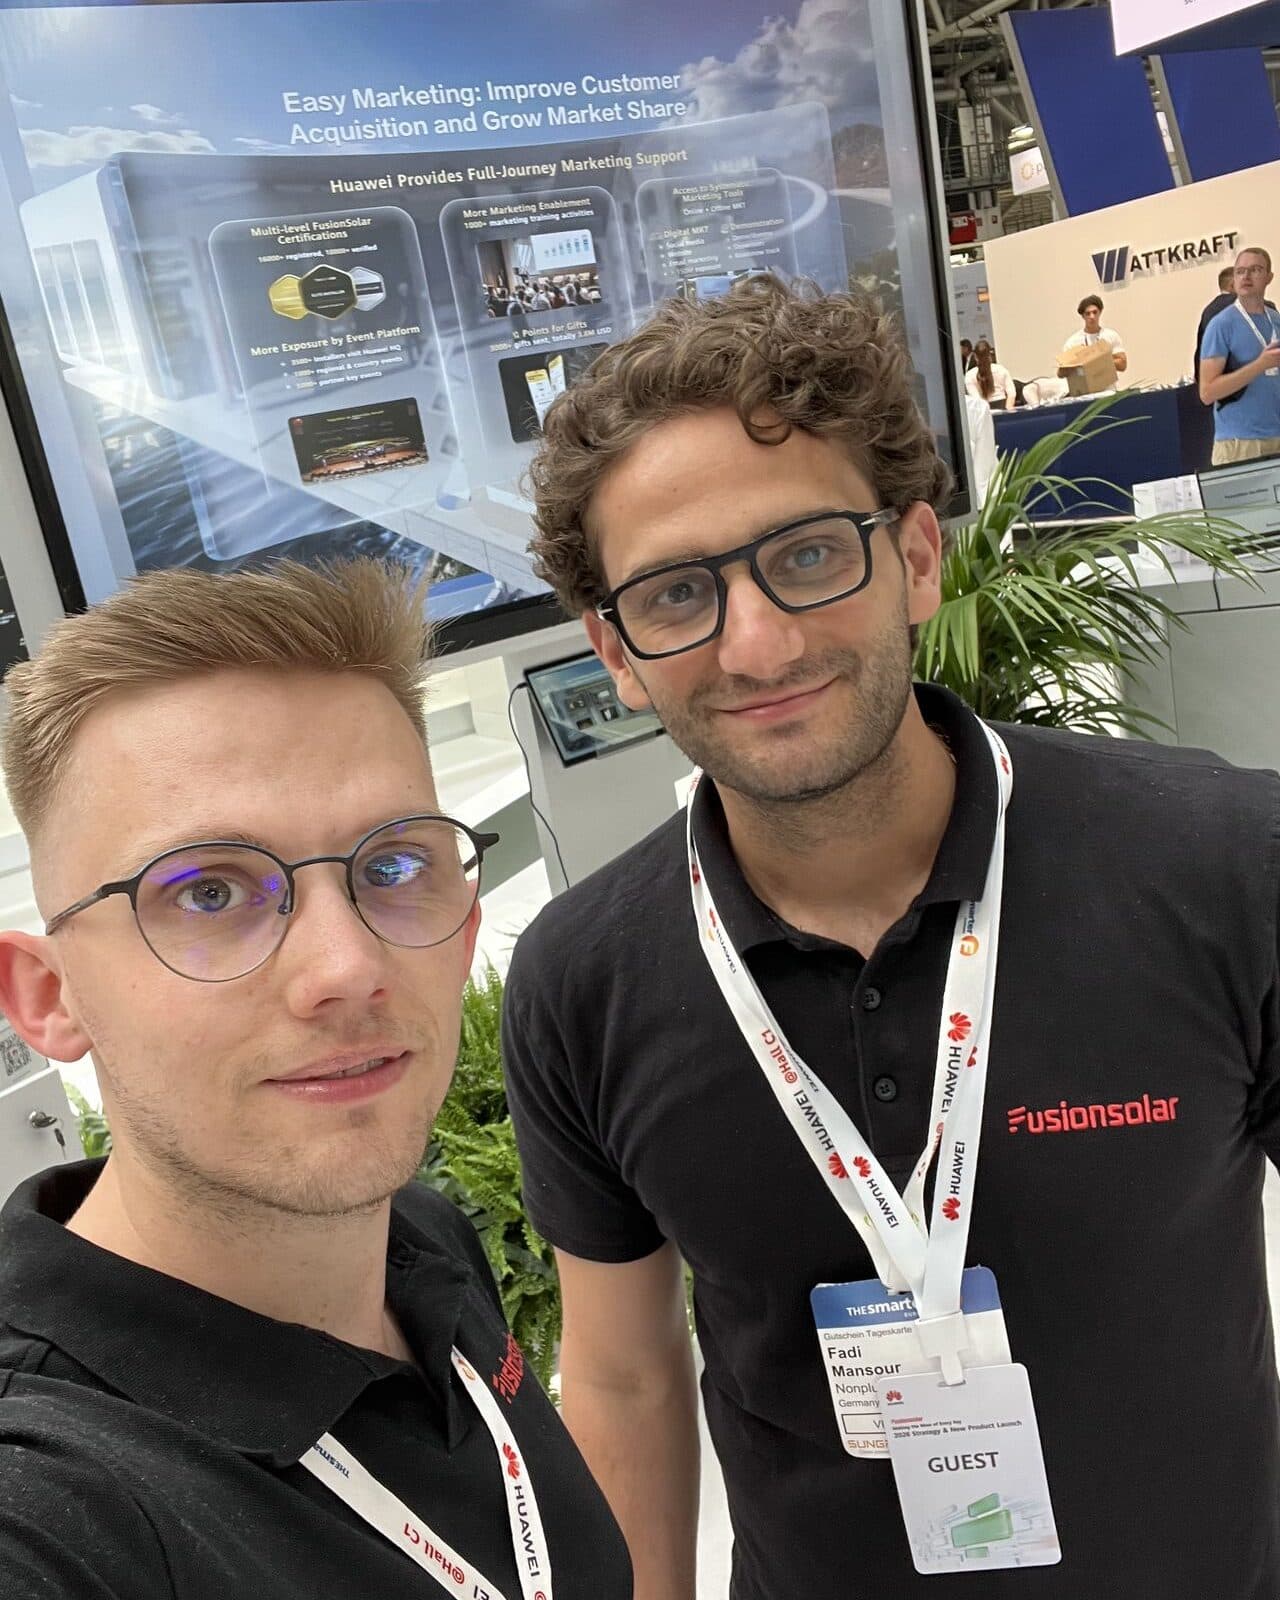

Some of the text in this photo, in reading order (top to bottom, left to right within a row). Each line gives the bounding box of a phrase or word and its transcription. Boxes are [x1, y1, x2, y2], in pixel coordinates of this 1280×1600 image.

[282, 73, 681, 115] Easy Marketing: Improve Customer
[290, 100, 687, 147] Acquisition and Grow Market Share
[329, 149, 689, 194] Huawei Provides Full-Journey Marketing Support
[463, 197, 591, 218] More Marketing Enablement
[250, 217, 372, 237] Multi-level FusionSolar
[277, 229, 348, 245] Certifications
[251, 325, 421, 357] More Exposure by Event Platform
[761, 1028, 836, 1152] HUAWEI @Hall C1
[940, 1046, 962, 1114] HUAWEI
[1007, 1093, 1180, 1134] Fusionsolar
[950, 1141, 966, 1195] HUAWEI
[867, 1178, 899, 1229] HUAWEI
[846, 1297, 913, 1317] THEsmart
[823, 1325, 913, 1341] Gutschein Tageskarte
[827, 1345, 862, 1360] Fadi
[832, 1362, 901, 1377] Mansour
[838, 1398, 880, 1409] Germany
[928, 1451, 999, 1473] GUEST
[513, 1485, 541, 1578] HUAWEI
[403, 1522, 466, 1585] @Hall C1
